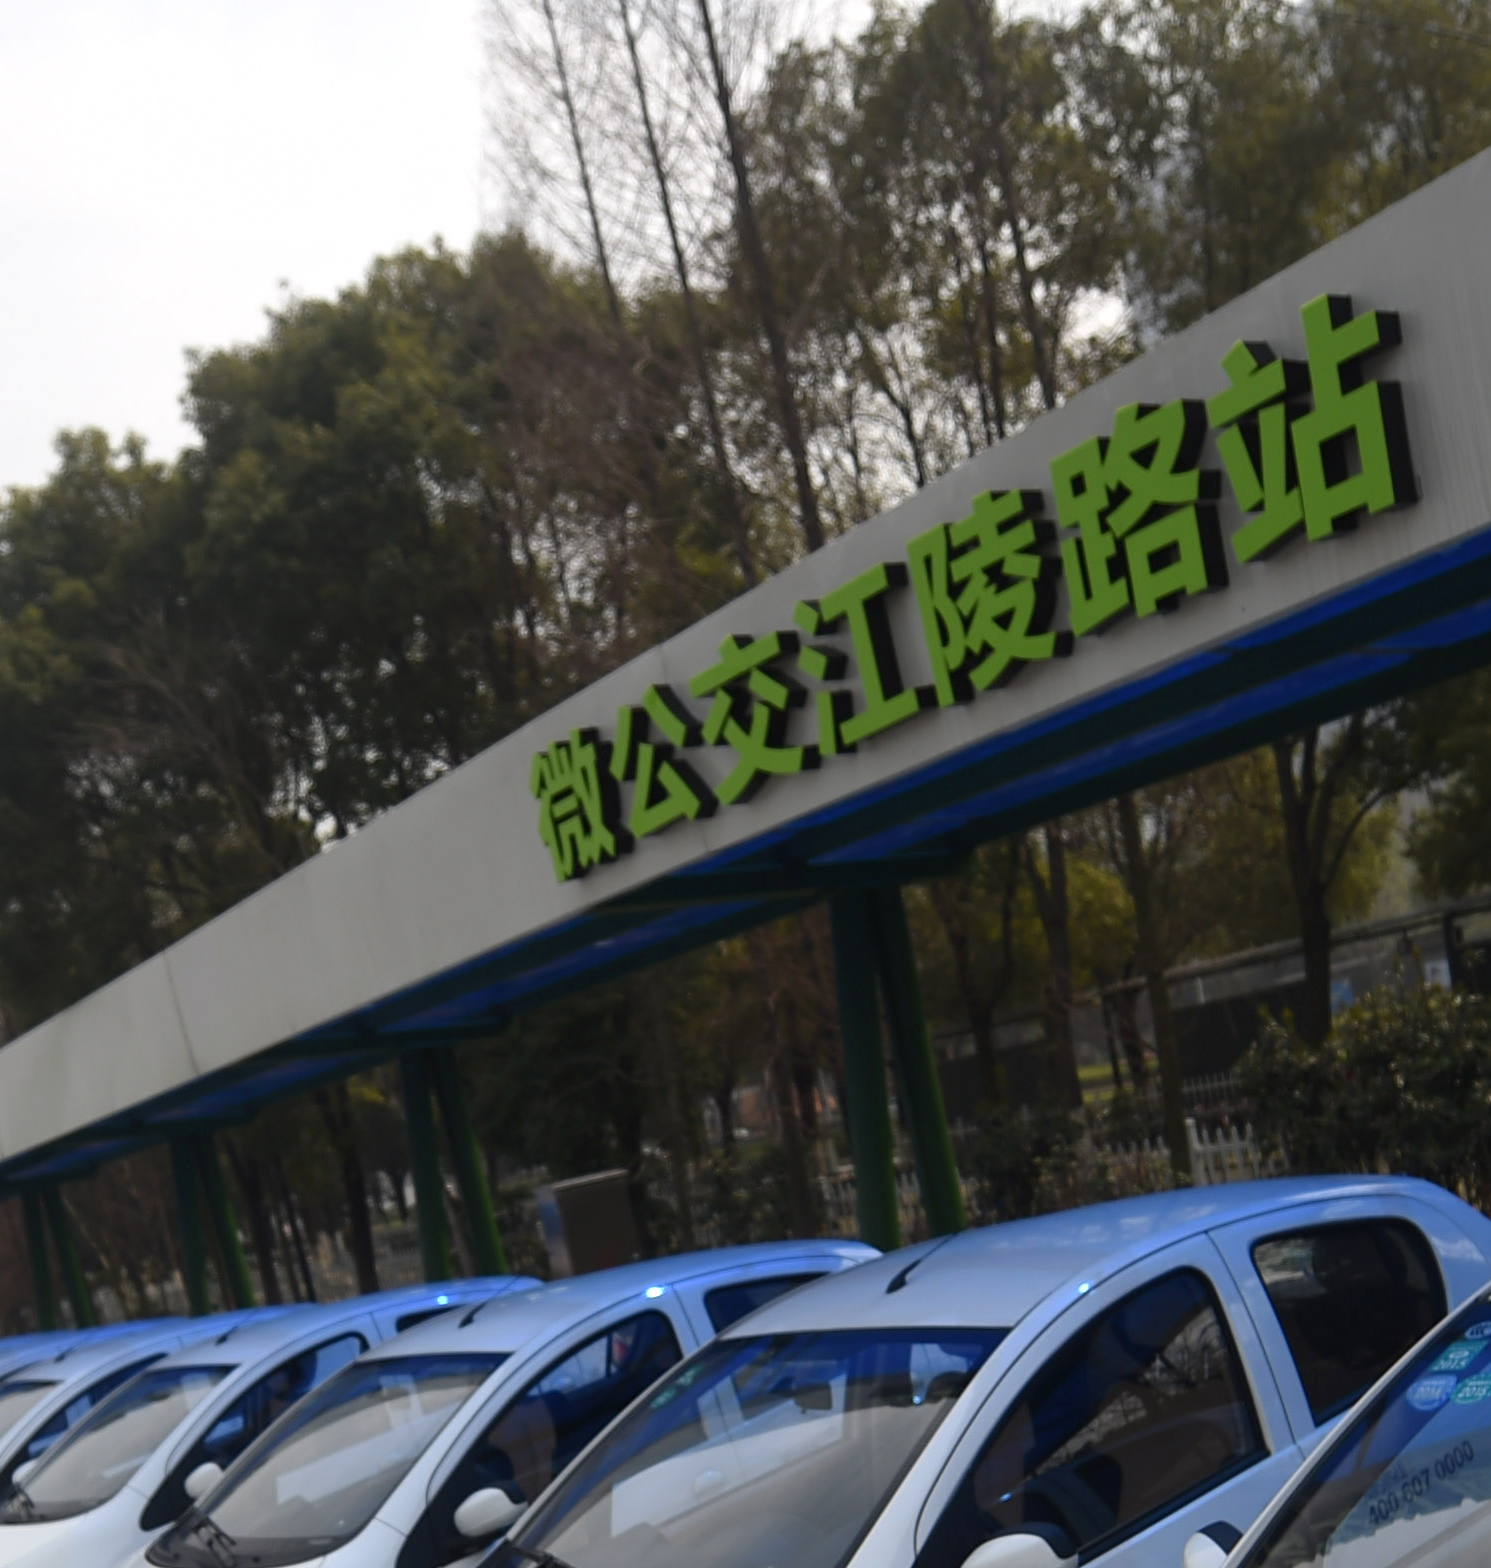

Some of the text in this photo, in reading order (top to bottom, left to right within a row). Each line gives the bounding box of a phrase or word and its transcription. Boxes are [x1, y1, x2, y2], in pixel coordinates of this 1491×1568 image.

[531, 293, 1404, 882] 微公交江陵路站
[1369, 1491, 1399, 1526] 400
[1402, 1467, 1431, 1503] 607
[1434, 1440, 1475, 1480] 0000
